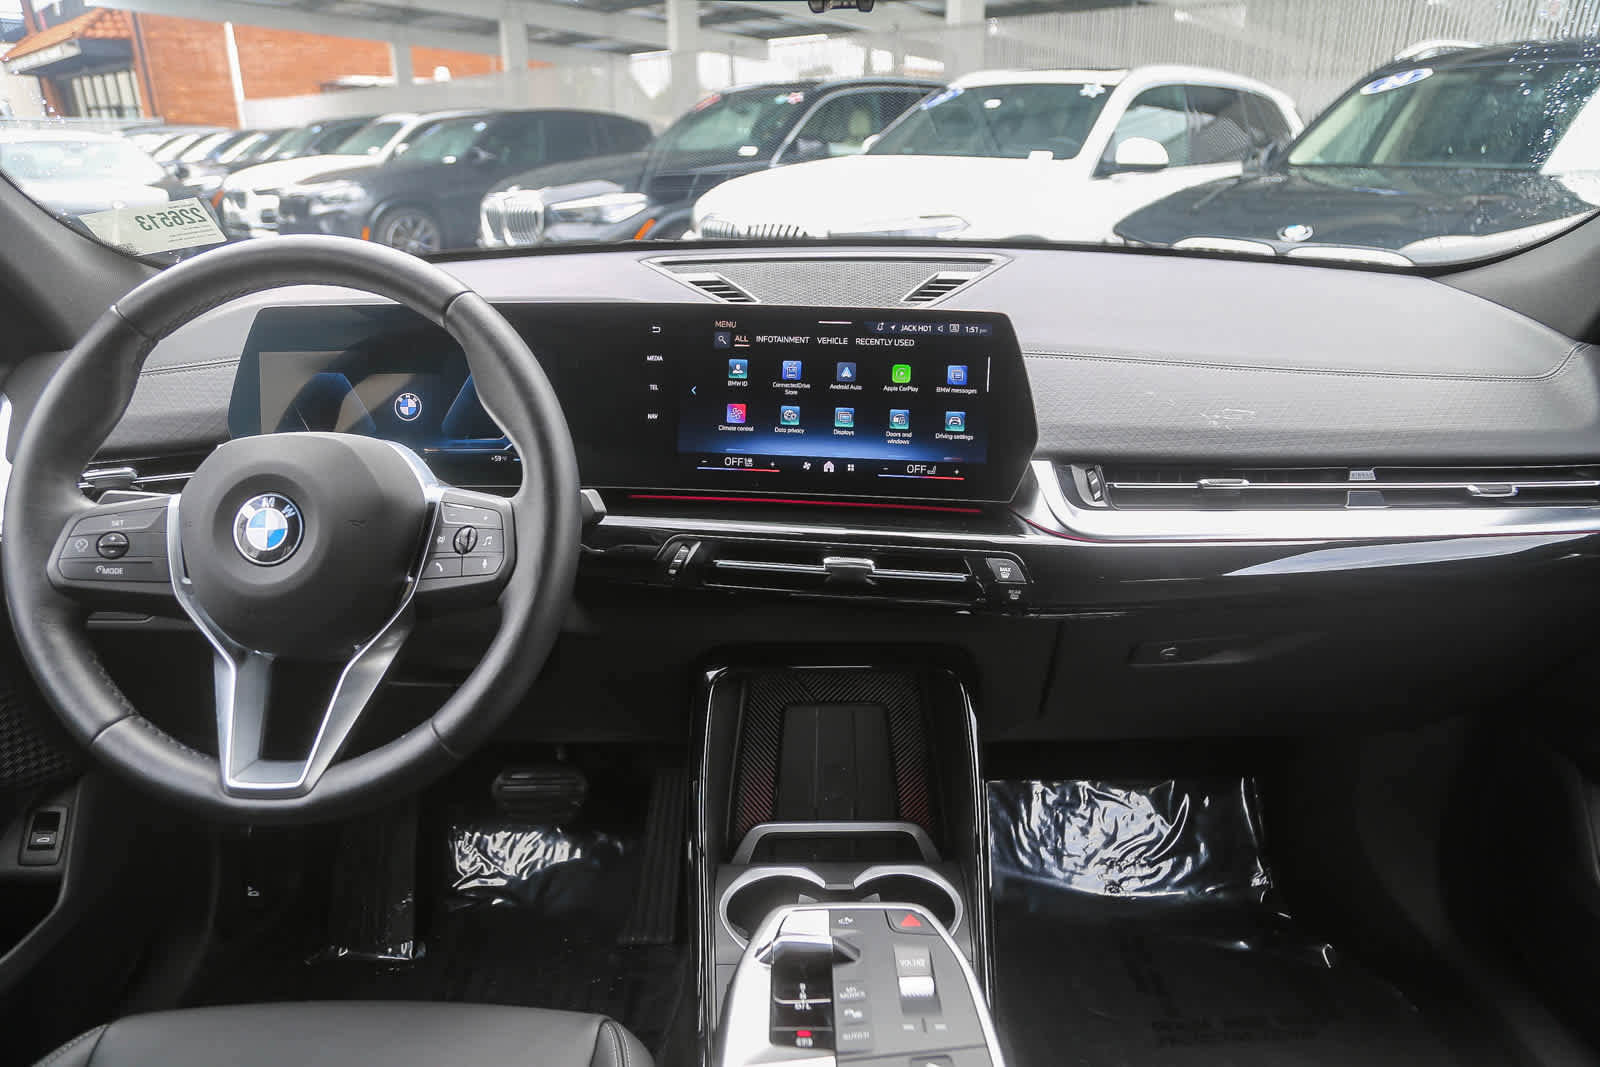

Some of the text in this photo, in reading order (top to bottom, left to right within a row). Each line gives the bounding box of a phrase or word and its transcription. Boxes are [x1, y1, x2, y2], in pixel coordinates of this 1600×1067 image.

[715, 320, 737, 329] MENU
[901, 324, 917, 332] JACK
[734, 335, 749, 343] ALL
[755, 335, 811, 344] INFOTAINMENT
[816, 337, 849, 345] VEHICLE
[855, 338, 915, 347] RECENTLY USED
[724, 456, 744, 467] OFF
[906, 464, 927, 474] OFF
[102, 567, 124, 575] MODE
